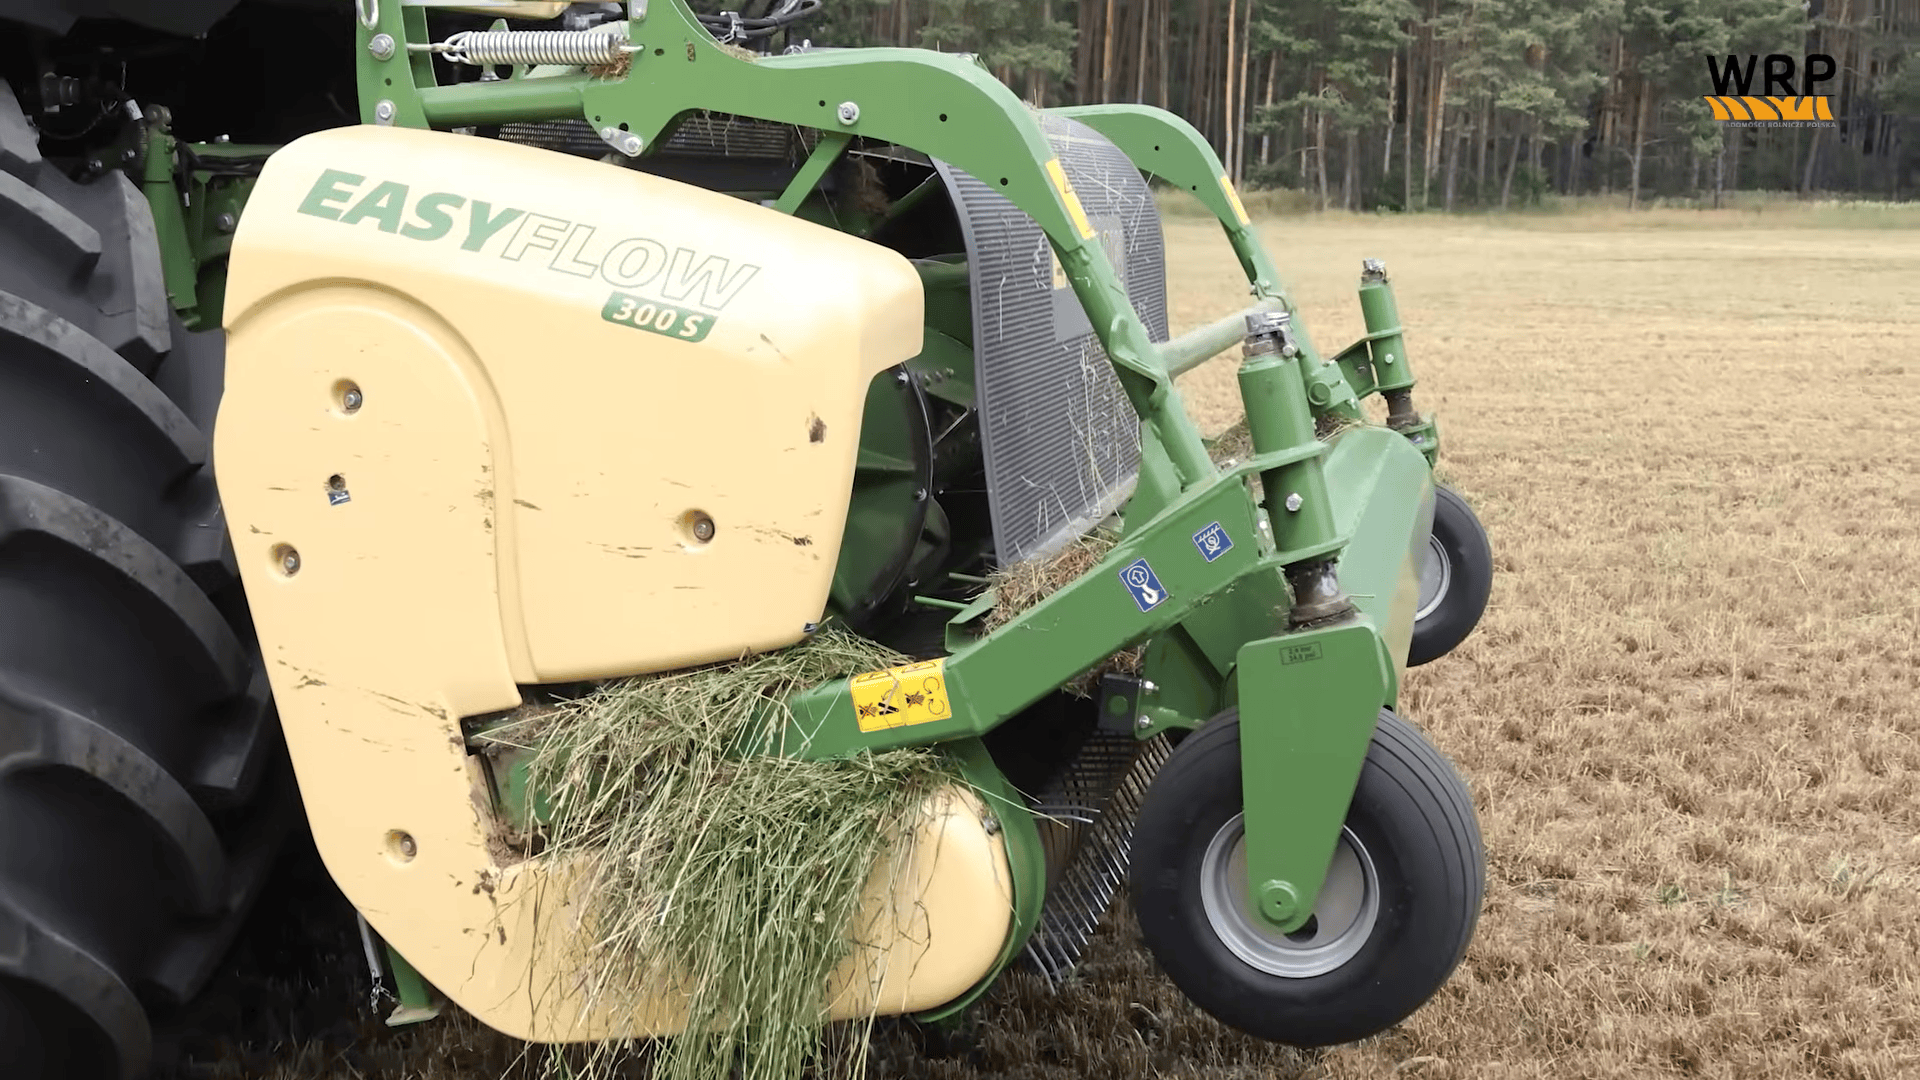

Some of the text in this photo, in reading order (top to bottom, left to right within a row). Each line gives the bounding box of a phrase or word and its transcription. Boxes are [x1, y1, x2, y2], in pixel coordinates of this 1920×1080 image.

[297, 167, 761, 312] EASYFLOW
[613, 298, 705, 338] 300 S
